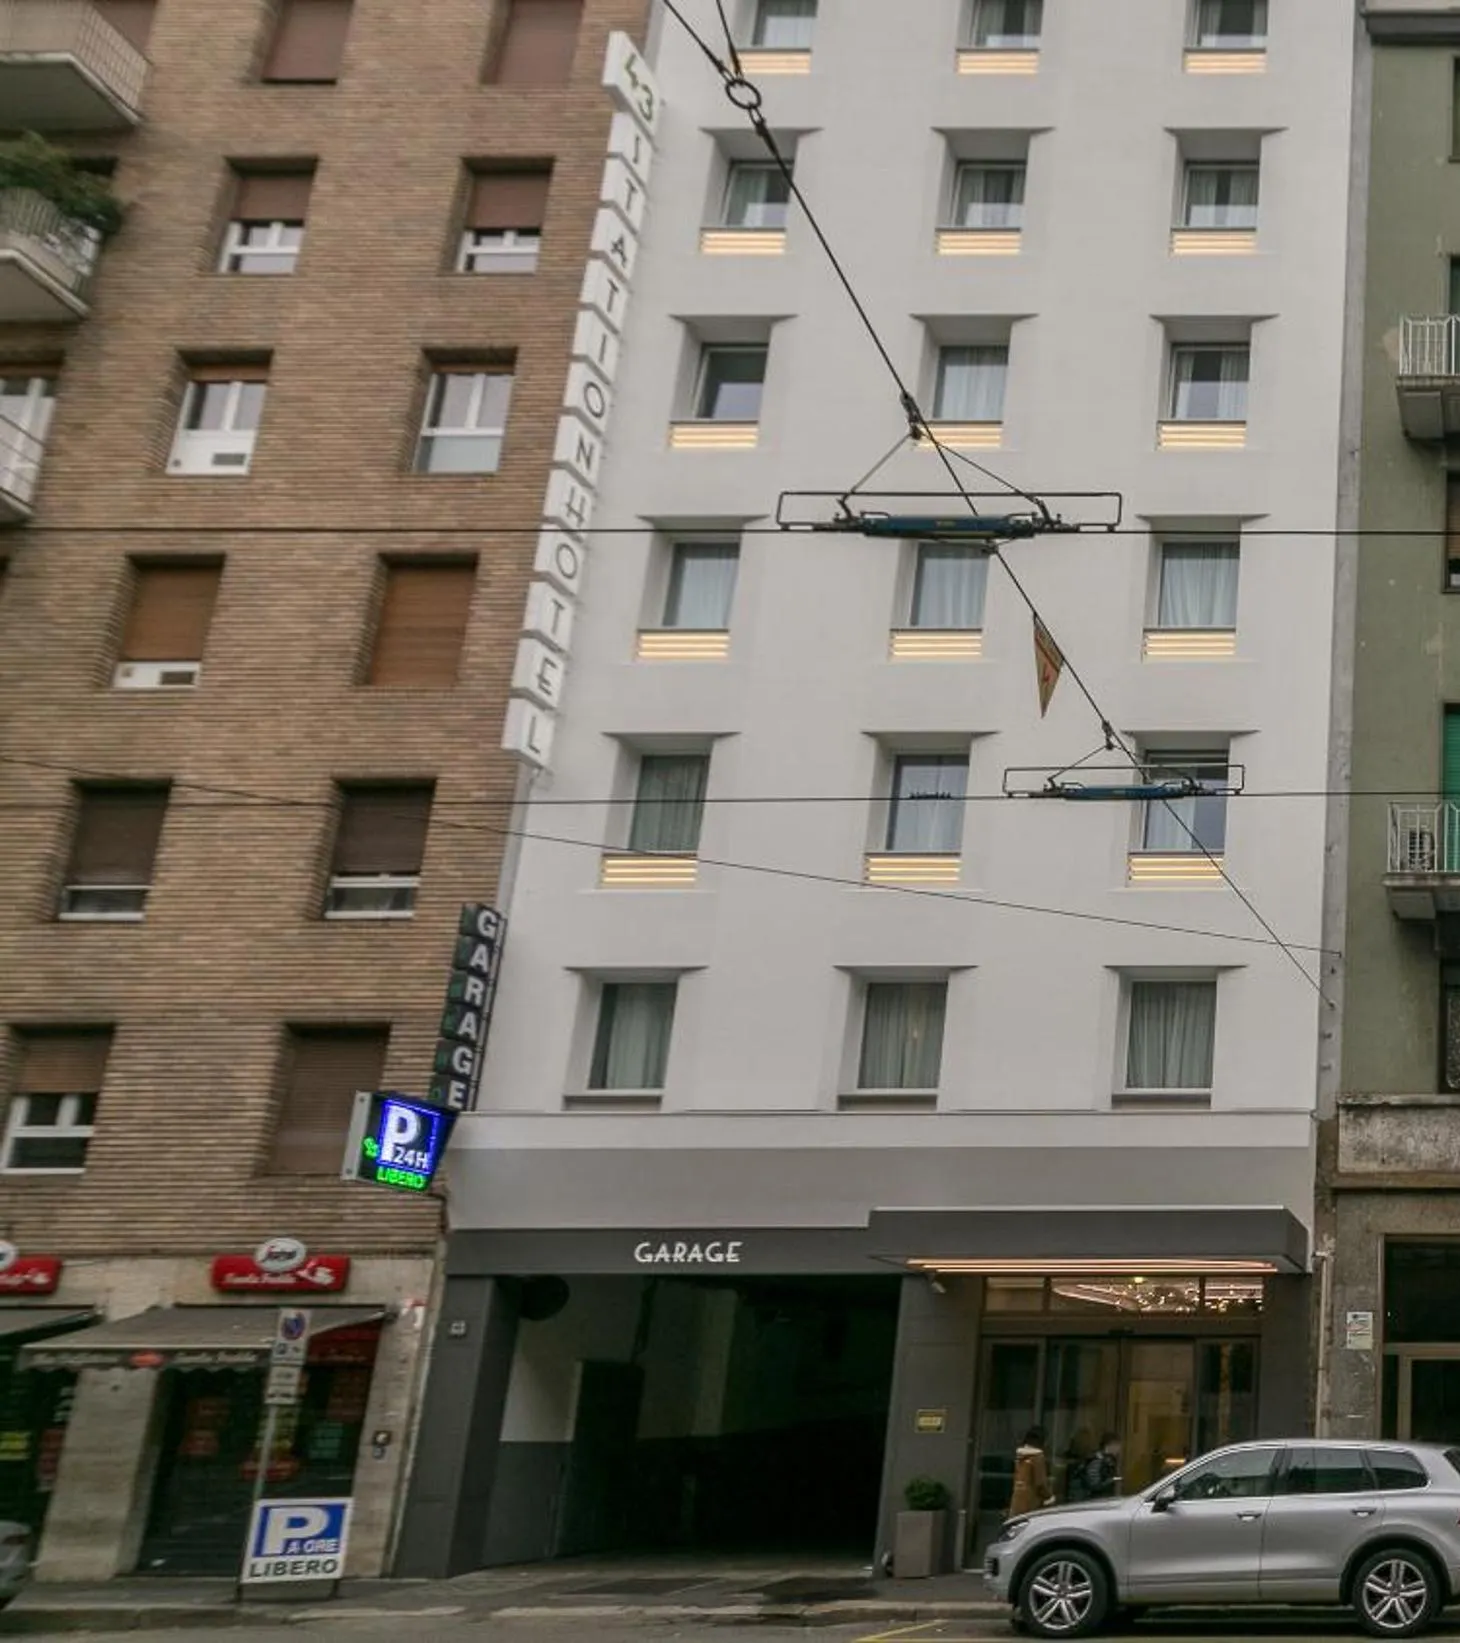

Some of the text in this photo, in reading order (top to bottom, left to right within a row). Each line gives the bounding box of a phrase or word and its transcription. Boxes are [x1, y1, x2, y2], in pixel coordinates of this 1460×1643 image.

[526, 487, 586, 755] HOTEL
[448, 909, 498, 1109] GARAGE
[381, 1105, 429, 1169] P 24H
[634, 1241, 743, 1263] GARAGE
[261, 1507, 330, 1556] P
[286, 1541, 300, 1555] A
[248, 1559, 338, 1578] LIBERO
